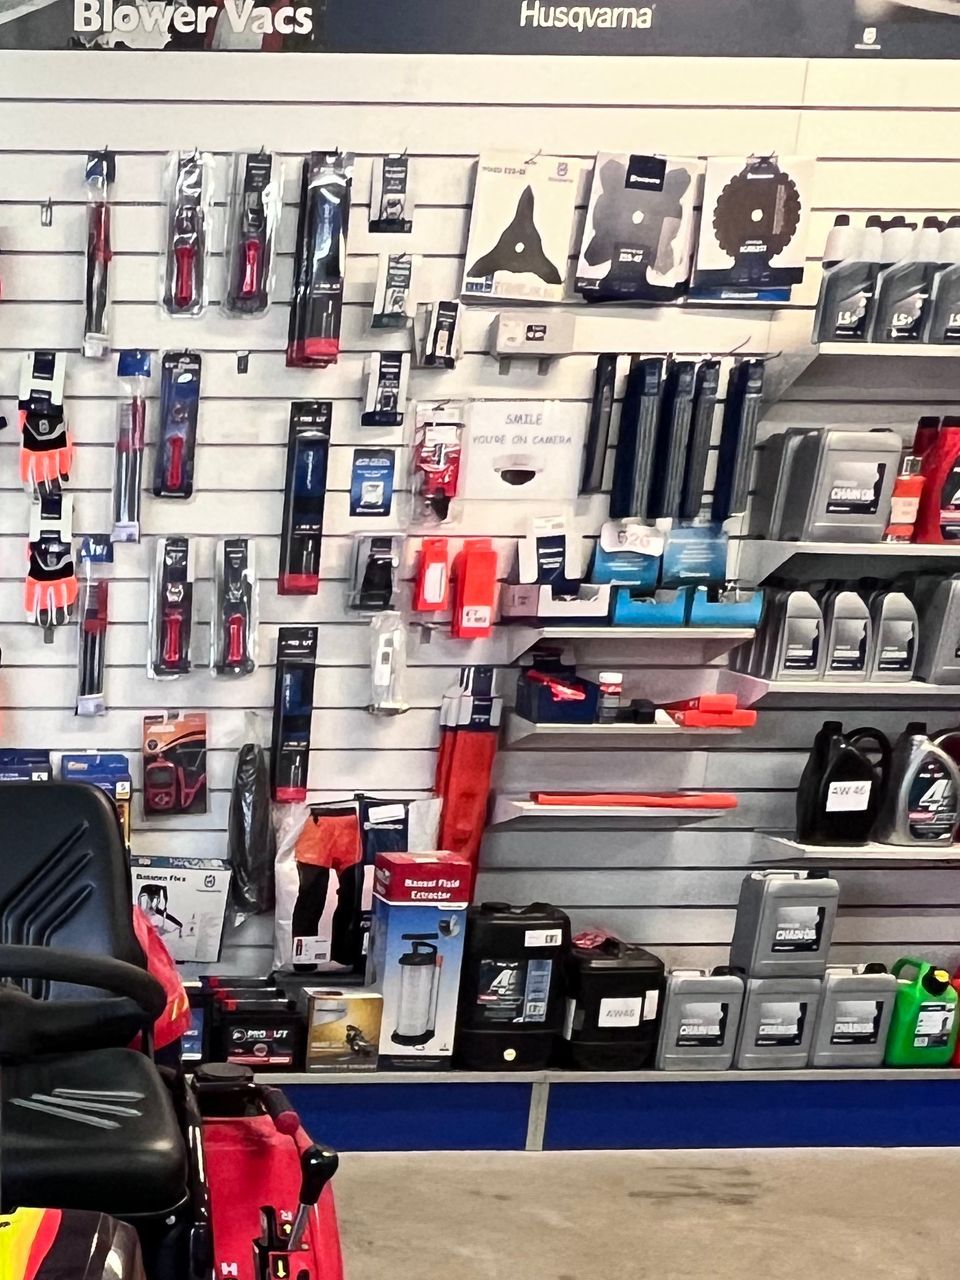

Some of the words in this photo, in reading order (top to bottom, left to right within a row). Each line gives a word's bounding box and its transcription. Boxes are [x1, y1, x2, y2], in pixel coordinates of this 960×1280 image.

[73, 0, 218, 33] Blower
[223, 0, 313, 34] Vacs
[519, 0, 653, 32] Husqvarna
[505, 413, 543, 426] SMILE
[511, 434, 528, 445] ON
[532, 434, 572, 445] CAMERA
